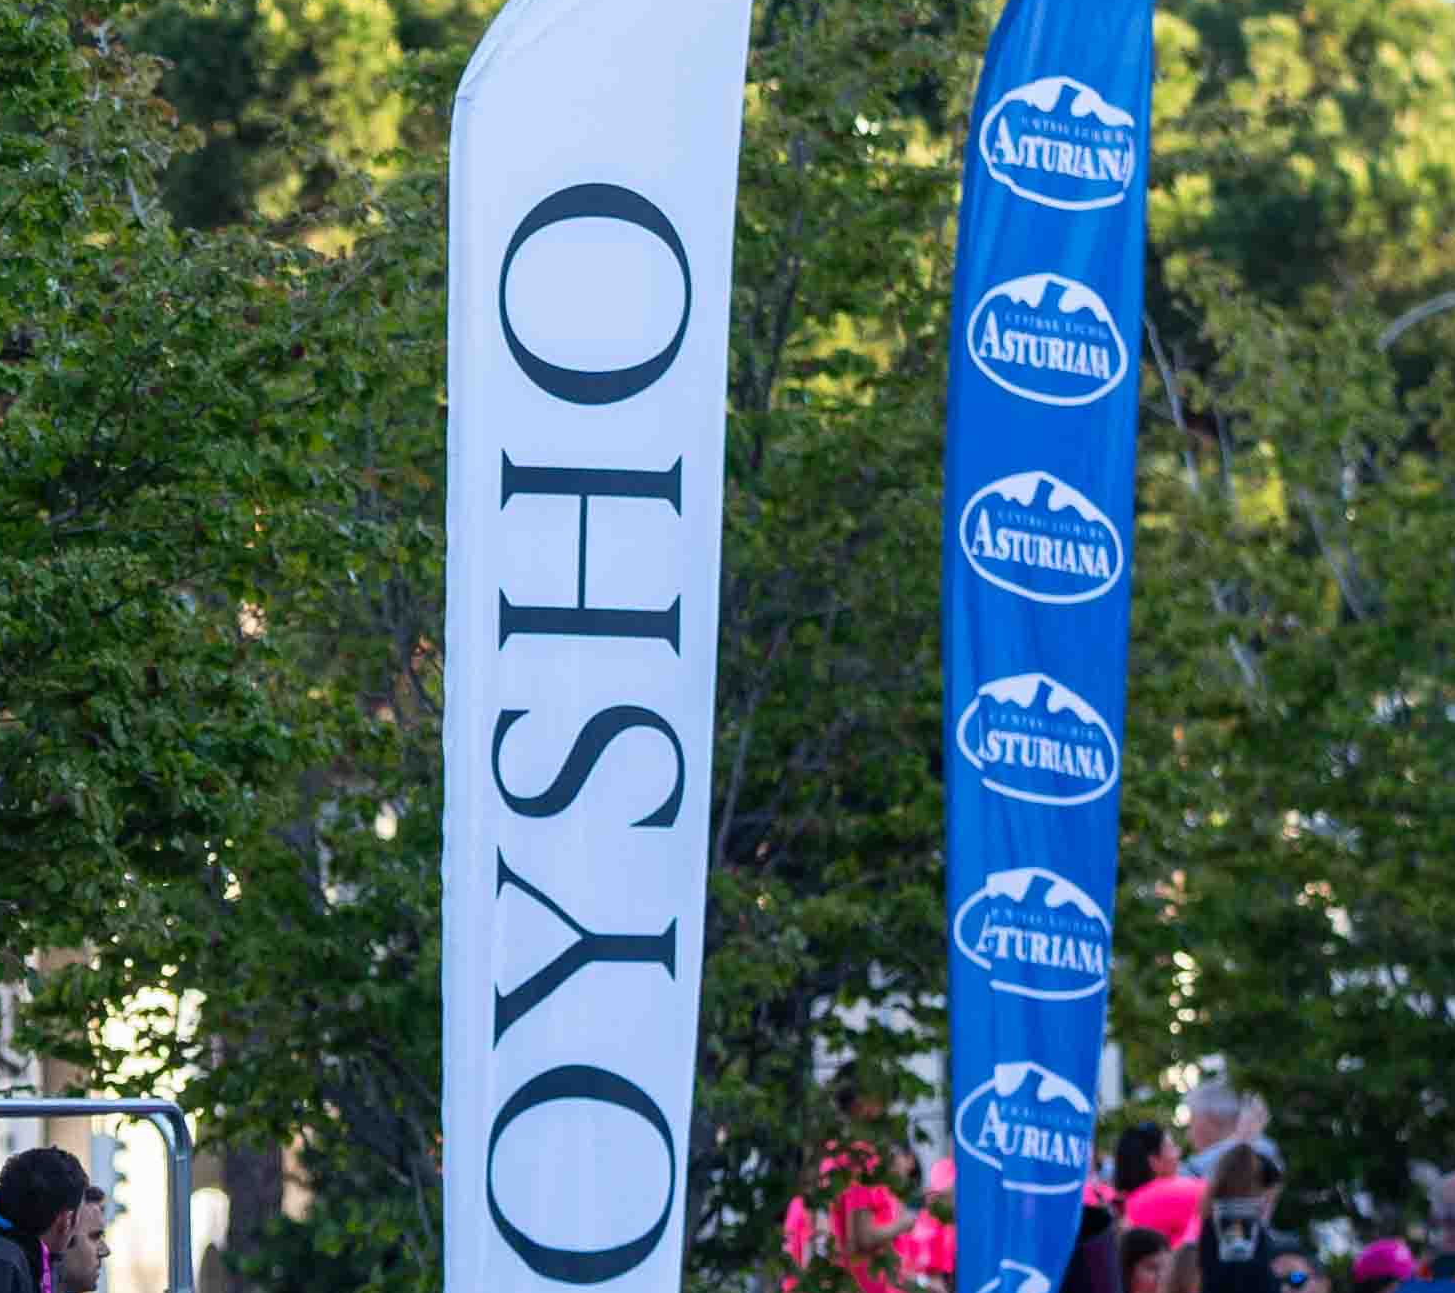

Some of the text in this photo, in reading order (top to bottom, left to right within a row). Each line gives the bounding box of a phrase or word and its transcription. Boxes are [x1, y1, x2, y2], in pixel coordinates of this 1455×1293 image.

[970, 508, 1110, 580] ASTURIANA
[486, 182, 692, 1286] OYSHO
[978, 710, 1107, 782] STURIANA
